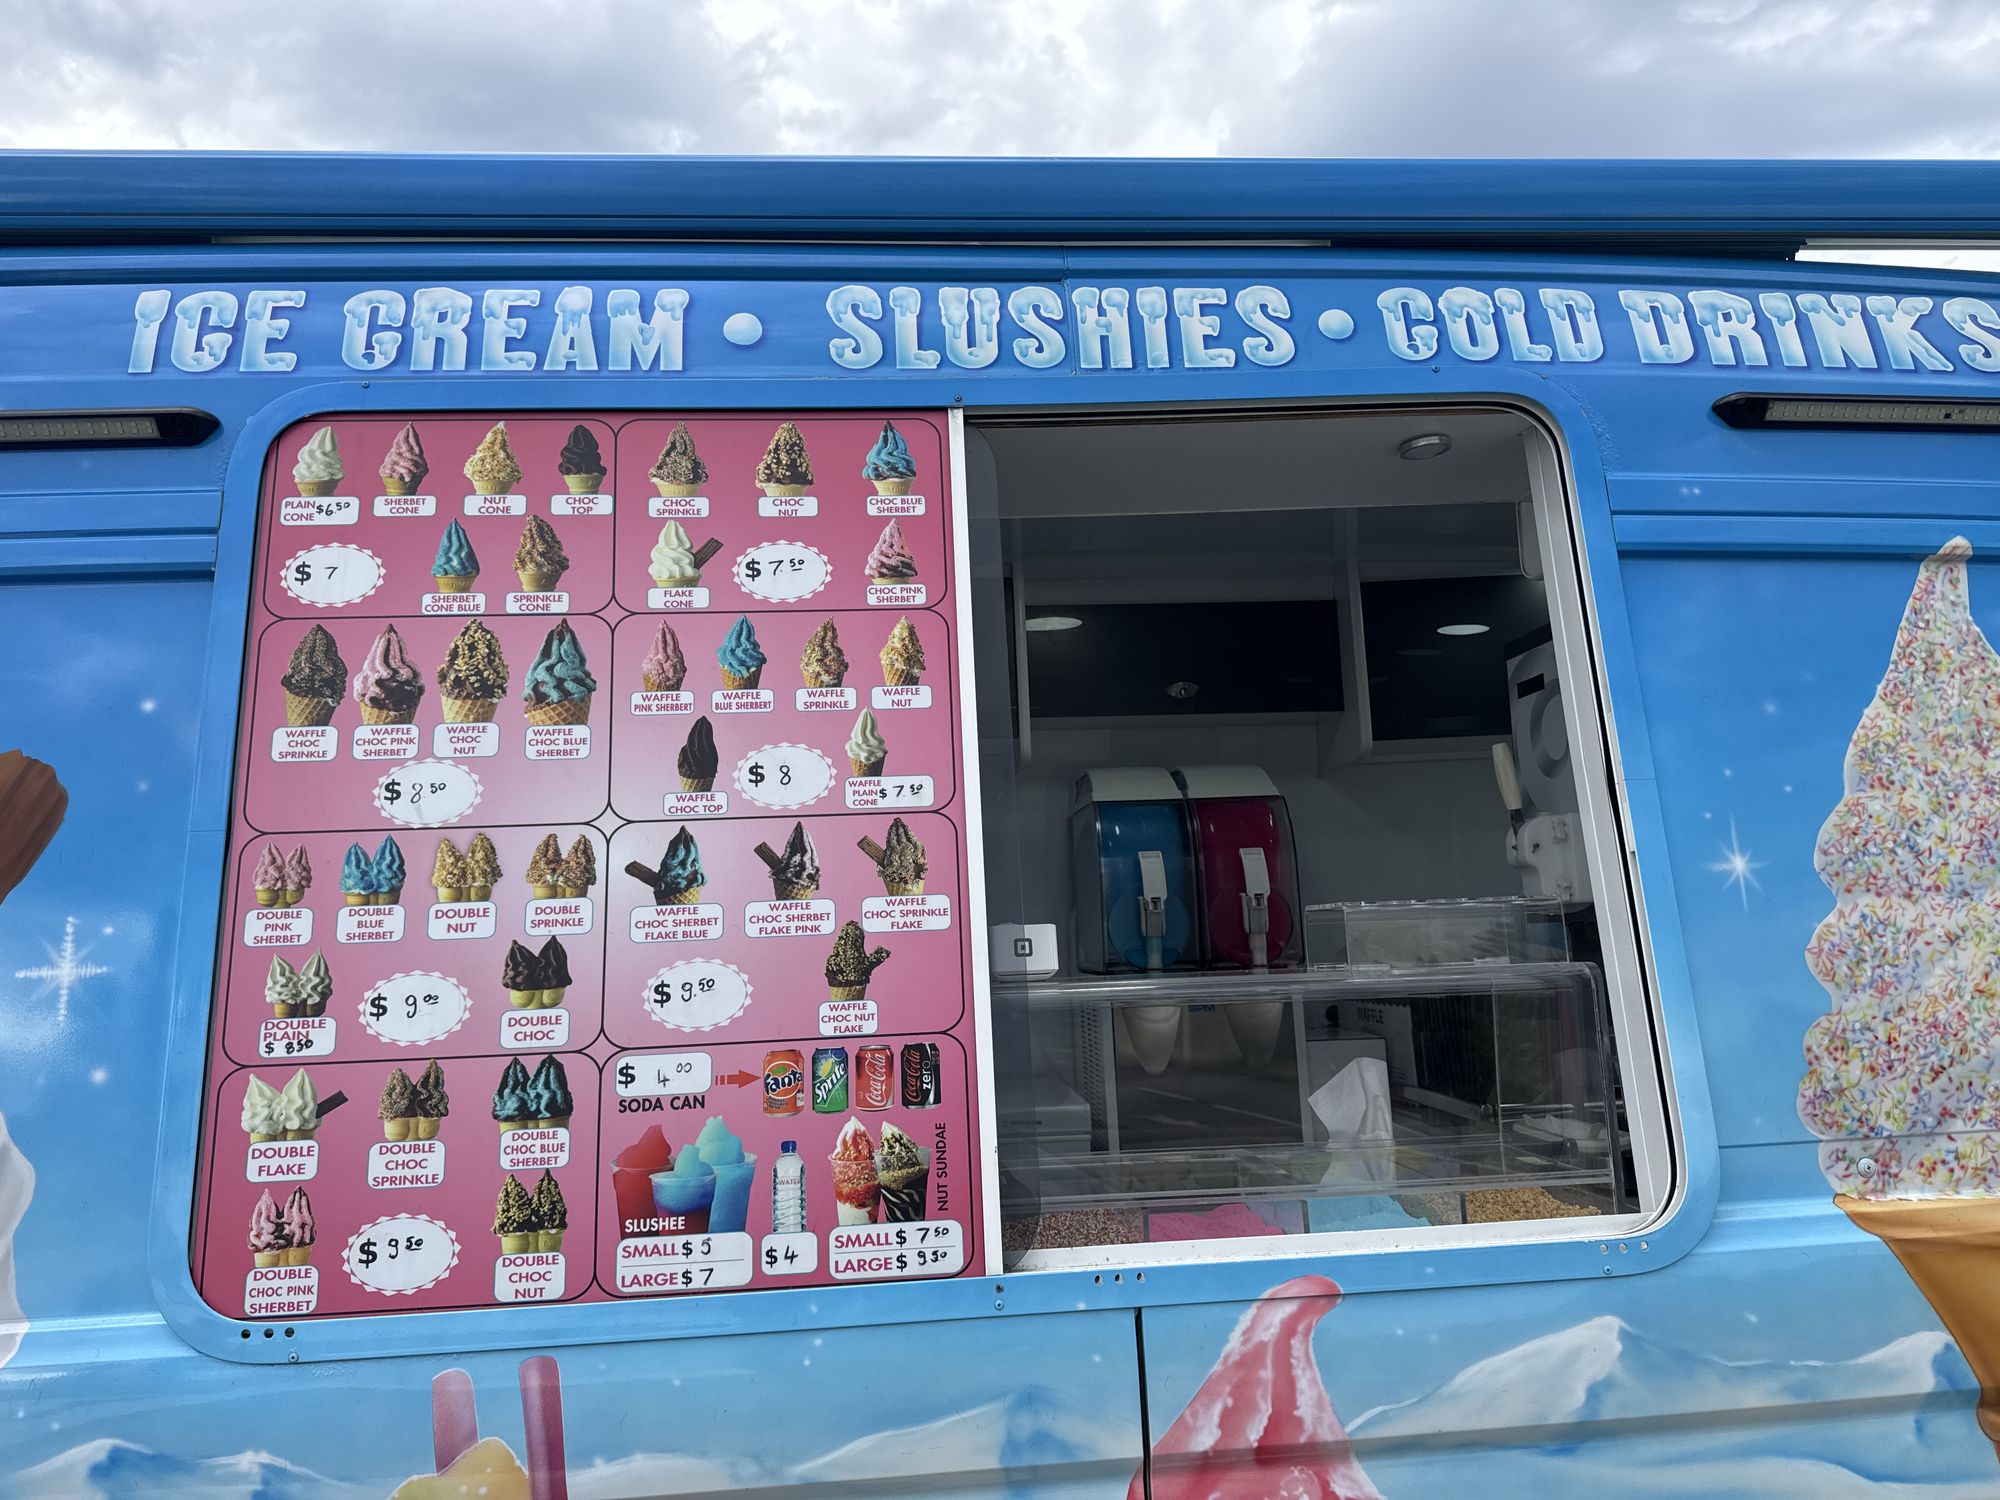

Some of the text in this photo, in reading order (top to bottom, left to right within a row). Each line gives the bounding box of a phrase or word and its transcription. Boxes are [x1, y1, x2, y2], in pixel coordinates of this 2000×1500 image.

[127, 285, 691, 374] ICE CREAM
[825, 284, 1297, 371] SLUSHIES
[1376, 286, 2000, 373] COLD DRINKS
[284, 501, 316, 509] PLAIN
[384, 498, 427, 506] SHERBET
[484, 497, 507, 505] NUT
[565, 497, 599, 505] CHOC
[662, 499, 696, 507] CHOC
[772, 498, 804, 506] CHOC
[869, 497, 923, 506] CHOC BLUE
[389, 506, 420, 514] CONE
[478, 505, 511, 514] CONE
[570, 506, 593, 514] TOP
[656, 507, 702, 516] SPRINKLE
[778, 508, 799, 516] NUT
[876, 506, 917, 514] SHERBET
[284, 513, 315, 522] CONE
[664, 589, 694, 598] FLAKE
[868, 586, 924, 595] CHOC PINK
[431, 595, 477, 603] SHERBET
[513, 594, 563, 603] SPRINKLE
[664, 599, 693, 608] CONE
[876, 595, 917, 603] SHERBET
[425, 603, 481, 612] CONE BLUE
[519, 603, 551, 611] CONE
[721, 691, 761, 700] WAFFLE
[806, 689, 845, 698] WAFFLE
[882, 687, 921, 696] WAFFLE
[641, 694, 681, 702] WAFFLE
[891, 698, 913, 707] NUT
[634, 702, 693, 712] PINK SHERBERT
[715, 700, 772, 710] BLUE SHERBERT
[803, 699, 849, 709] SPRINKLE
[285, 729, 327, 738] WAFFLE
[371, 727, 412, 736] WAFFLE
[446, 725, 488, 734] WAFFLE
[532, 728, 574, 737] WAFFLE
[288, 739, 319, 748] CHOC
[355, 737, 416, 746] CHOC PINK
[449, 735, 481, 744] CHOC
[528, 737, 588, 747] CHOC BLUE
[278, 749, 328, 759] SPRINKLE
[363, 748, 408, 757] SHERBET
[454, 746, 477, 755] NUT
[535, 748, 580, 757] SHERBET
[848, 780, 882, 788] WAFFLE
[675, 793, 716, 802] WAFFLE
[852, 789, 878, 797] PLAIN
[852, 798, 878, 806] CONE
[668, 803, 723, 814] CHOC TOP
[769, 901, 811, 912] WAFFLE
[885, 897, 927, 907] WAFFLE
[256, 910, 302, 920] DOUBLE
[348, 907, 394, 917] DOUBLE
[435, 907, 490, 920] DOUBLE
[534, 905, 581, 916] DOUBLE
[656, 906, 699, 916] WAFFLE
[864, 907, 949, 918] CHOC SPRINKLE
[530, 917, 584, 928] SPRINKLE
[635, 917, 719, 929] CHOC SHERBET
[749, 912, 831, 924] CHOC SHERBET
[264, 923, 293, 932] PINK
[357, 919, 384, 928] BLUE
[447, 922, 477, 934] NUT
[891, 920, 923, 929] FLAKE
[645, 928, 708, 940] FLAKE BLUE
[759, 924, 822, 935] FLAKE PINK
[253, 934, 303, 944] SHERBET
[346, 931, 394, 941] SHERBET
[829, 1002, 868, 1012] WAFFLE
[508, 1014, 562, 1027] DOUBLE
[821, 1012, 876, 1023] CHOC NUT
[1355, 1006, 1385, 1025] WAFFLE
[264, 1019, 327, 1030] DOUBLE
[833, 1024, 864, 1034] FLAKE
[264, 1030, 310, 1042] PLAIN
[513, 1029, 555, 1041] CHOC
[922, 1060, 931, 1090] zero
[764, 1069, 803, 1095] Fanta
[814, 1064, 846, 1104] Sprite
[618, 1095, 706, 1113] SODA CAN
[512, 1131, 559, 1141] DOUBLE
[251, 1145, 315, 1159] DOUBLE
[378, 1143, 436, 1155] DOUBLE
[503, 1142, 566, 1155] CHOC BLUE
[385, 1158, 428, 1171] CHOC
[509, 1156, 559, 1167] SHERBET
[935, 1122, 948, 1211] NUT SUNDAE
[258, 1163, 306, 1177] FLAKE
[372, 1173, 440, 1187] SPRINKLE
[625, 1217, 685, 1232] SLUSHEE
[834, 1234, 893, 1248] SMALL
[622, 1244, 679, 1258] SMALL
[502, 1255, 560, 1268] DOUBLE
[834, 1258, 893, 1273] LARGE
[253, 1268, 312, 1281] DOUBLE
[508, 1271, 552, 1283] CHOC
[621, 1273, 678, 1288] LARGE
[249, 1284, 315, 1298] CHOC PINK
[514, 1288, 546, 1299] NUT
[249, 1300, 312, 1314] SHERBET
